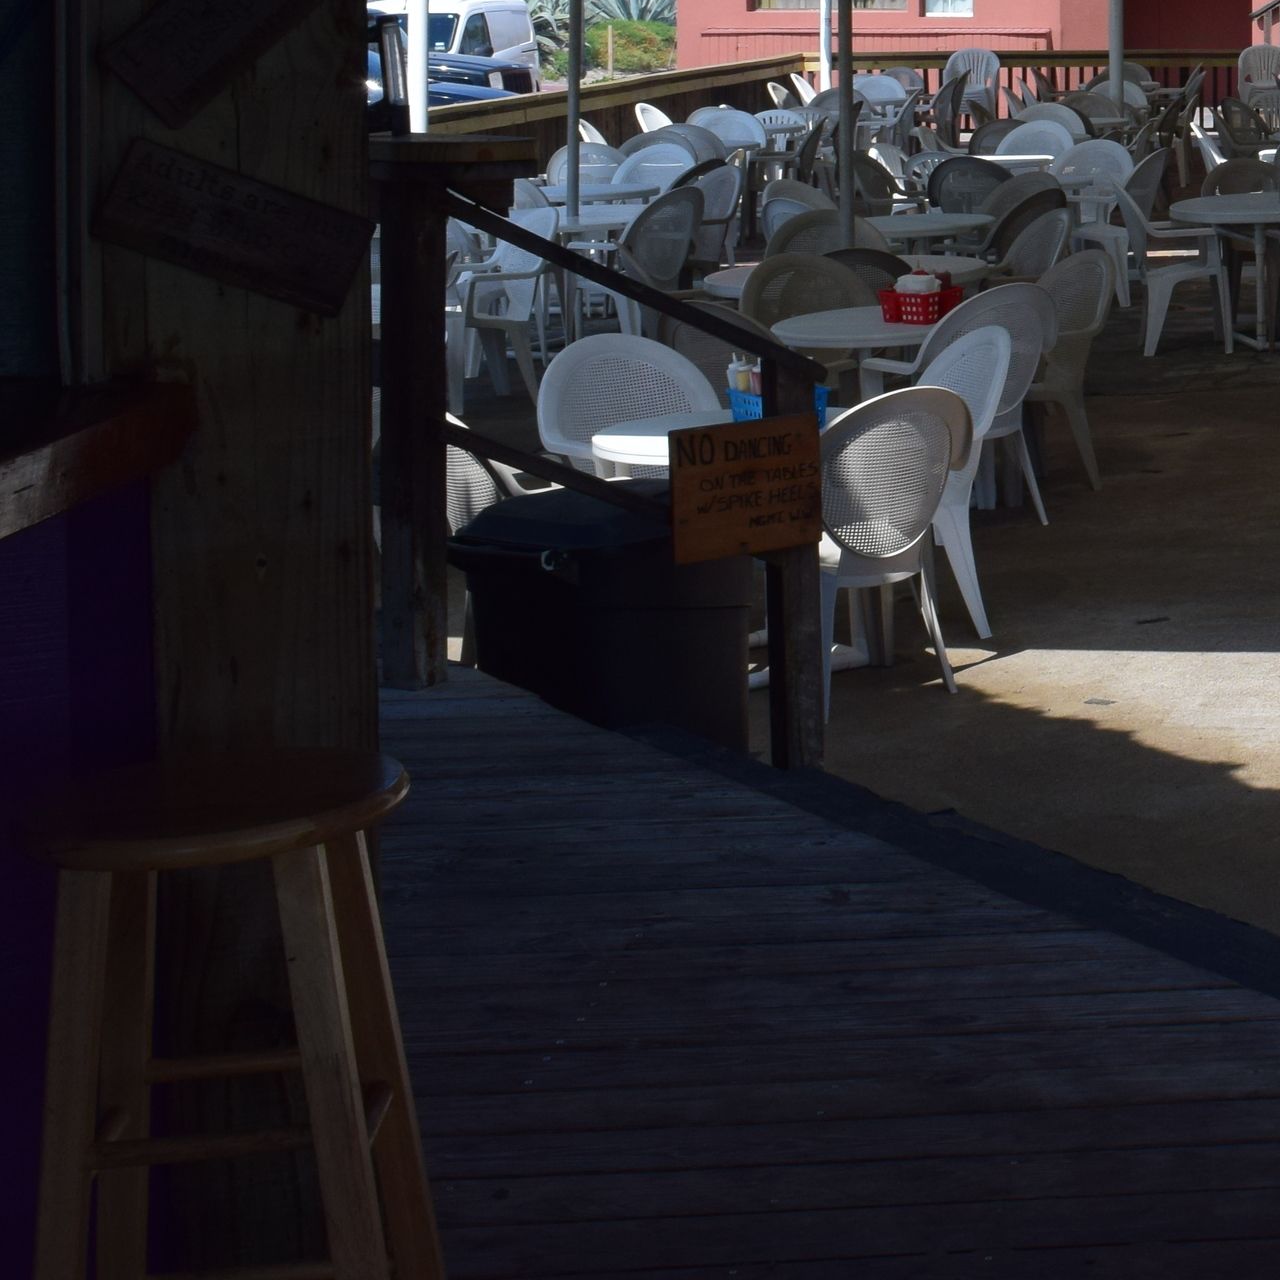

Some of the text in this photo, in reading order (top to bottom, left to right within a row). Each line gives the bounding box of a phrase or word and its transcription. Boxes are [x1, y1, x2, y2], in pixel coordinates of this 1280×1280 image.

[677, 433, 793, 467] NO DANCING
[701, 462, 818, 492] ON THE TABLES
